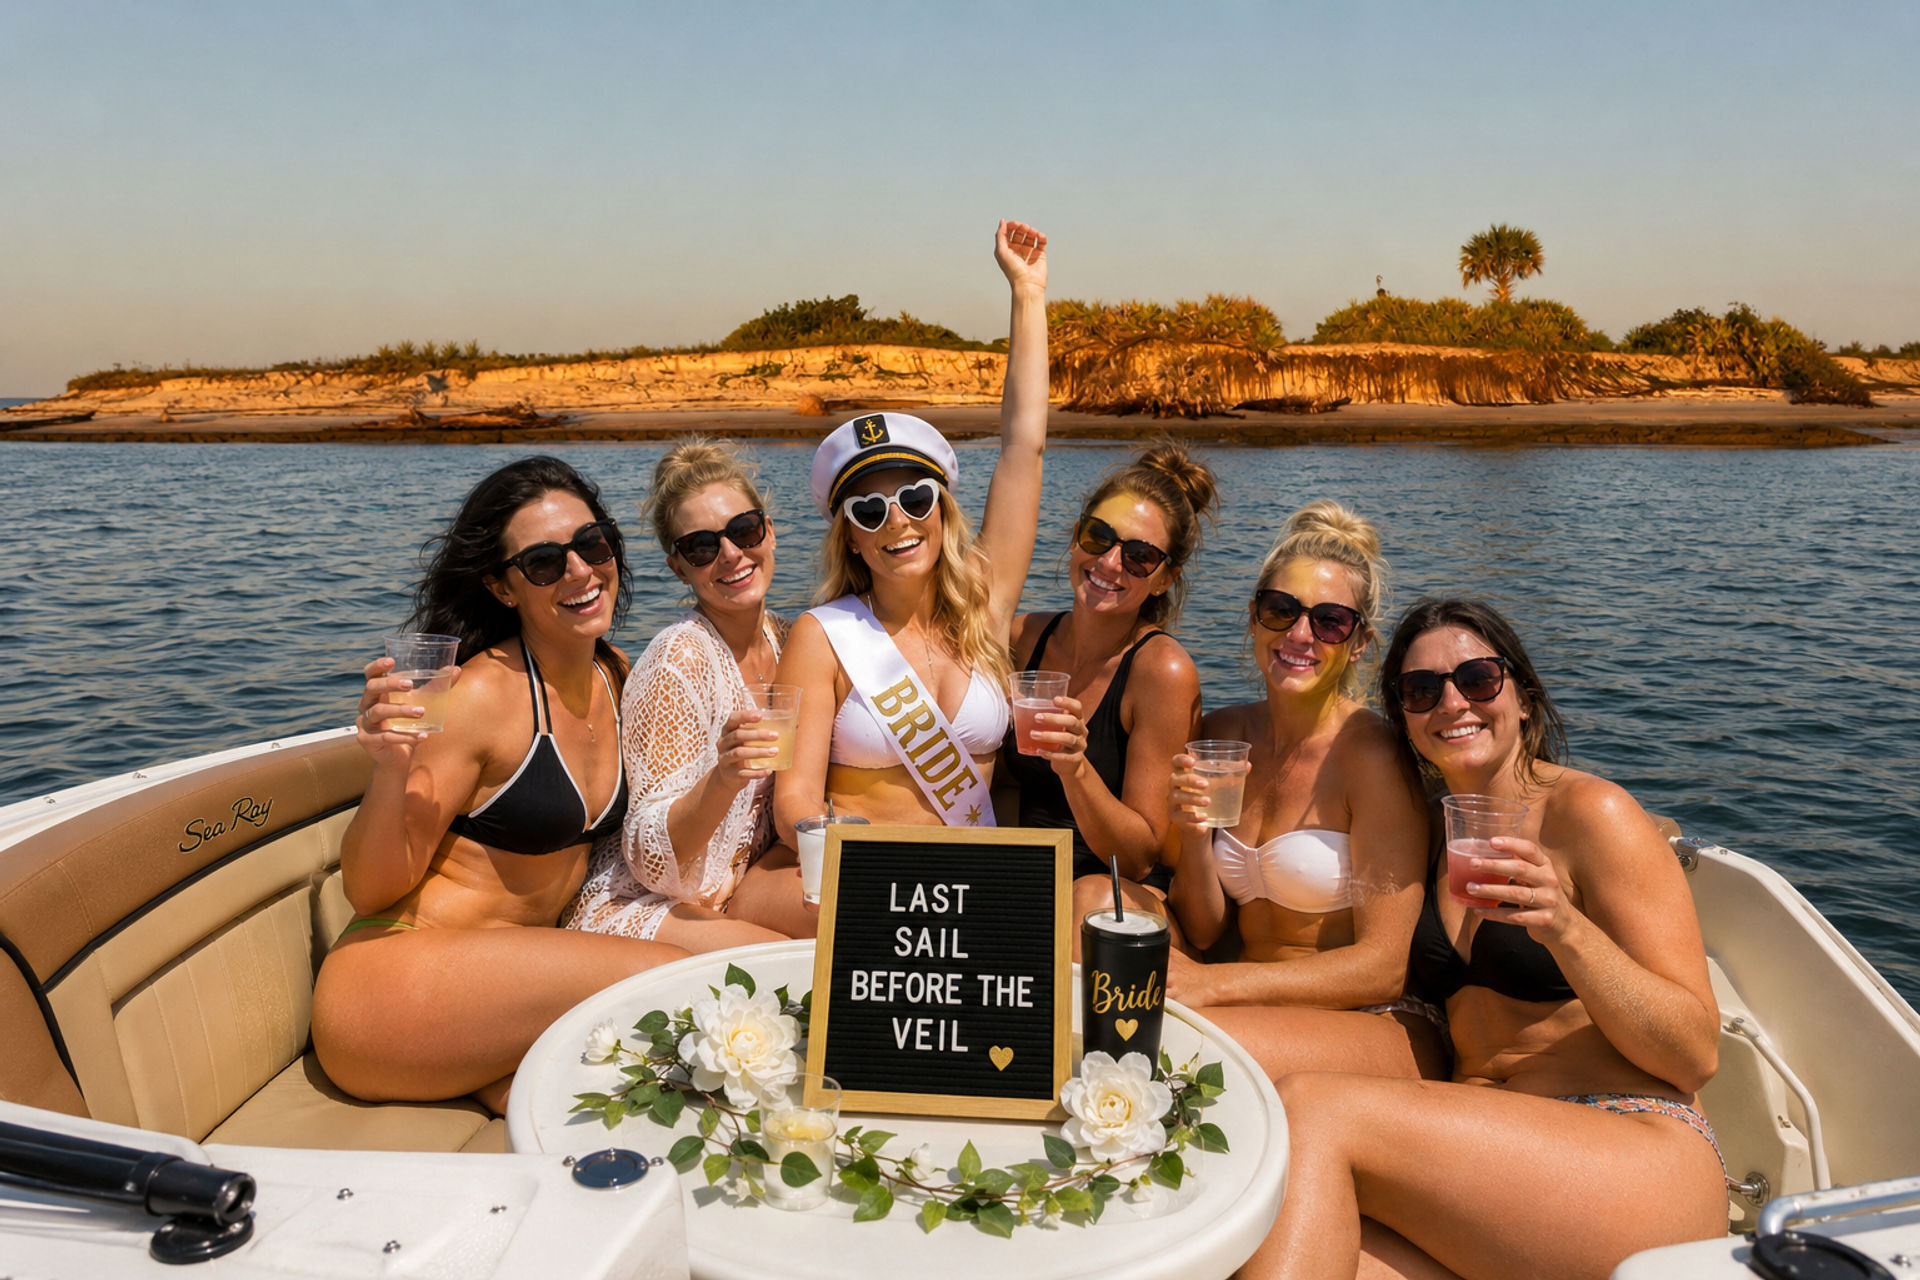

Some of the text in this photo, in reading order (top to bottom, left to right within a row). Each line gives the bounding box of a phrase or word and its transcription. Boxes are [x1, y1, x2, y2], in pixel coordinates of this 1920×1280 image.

[870, 675, 978, 811] BRIDE
[179, 797, 273, 853] Sea Ray
[890, 882, 970, 914] LAST
[894, 926, 969, 959] SAIL
[851, 970, 1034, 1008] BEFORE THE
[1091, 969, 1163, 1014] Bride
[892, 1017, 969, 1052] VEIL
